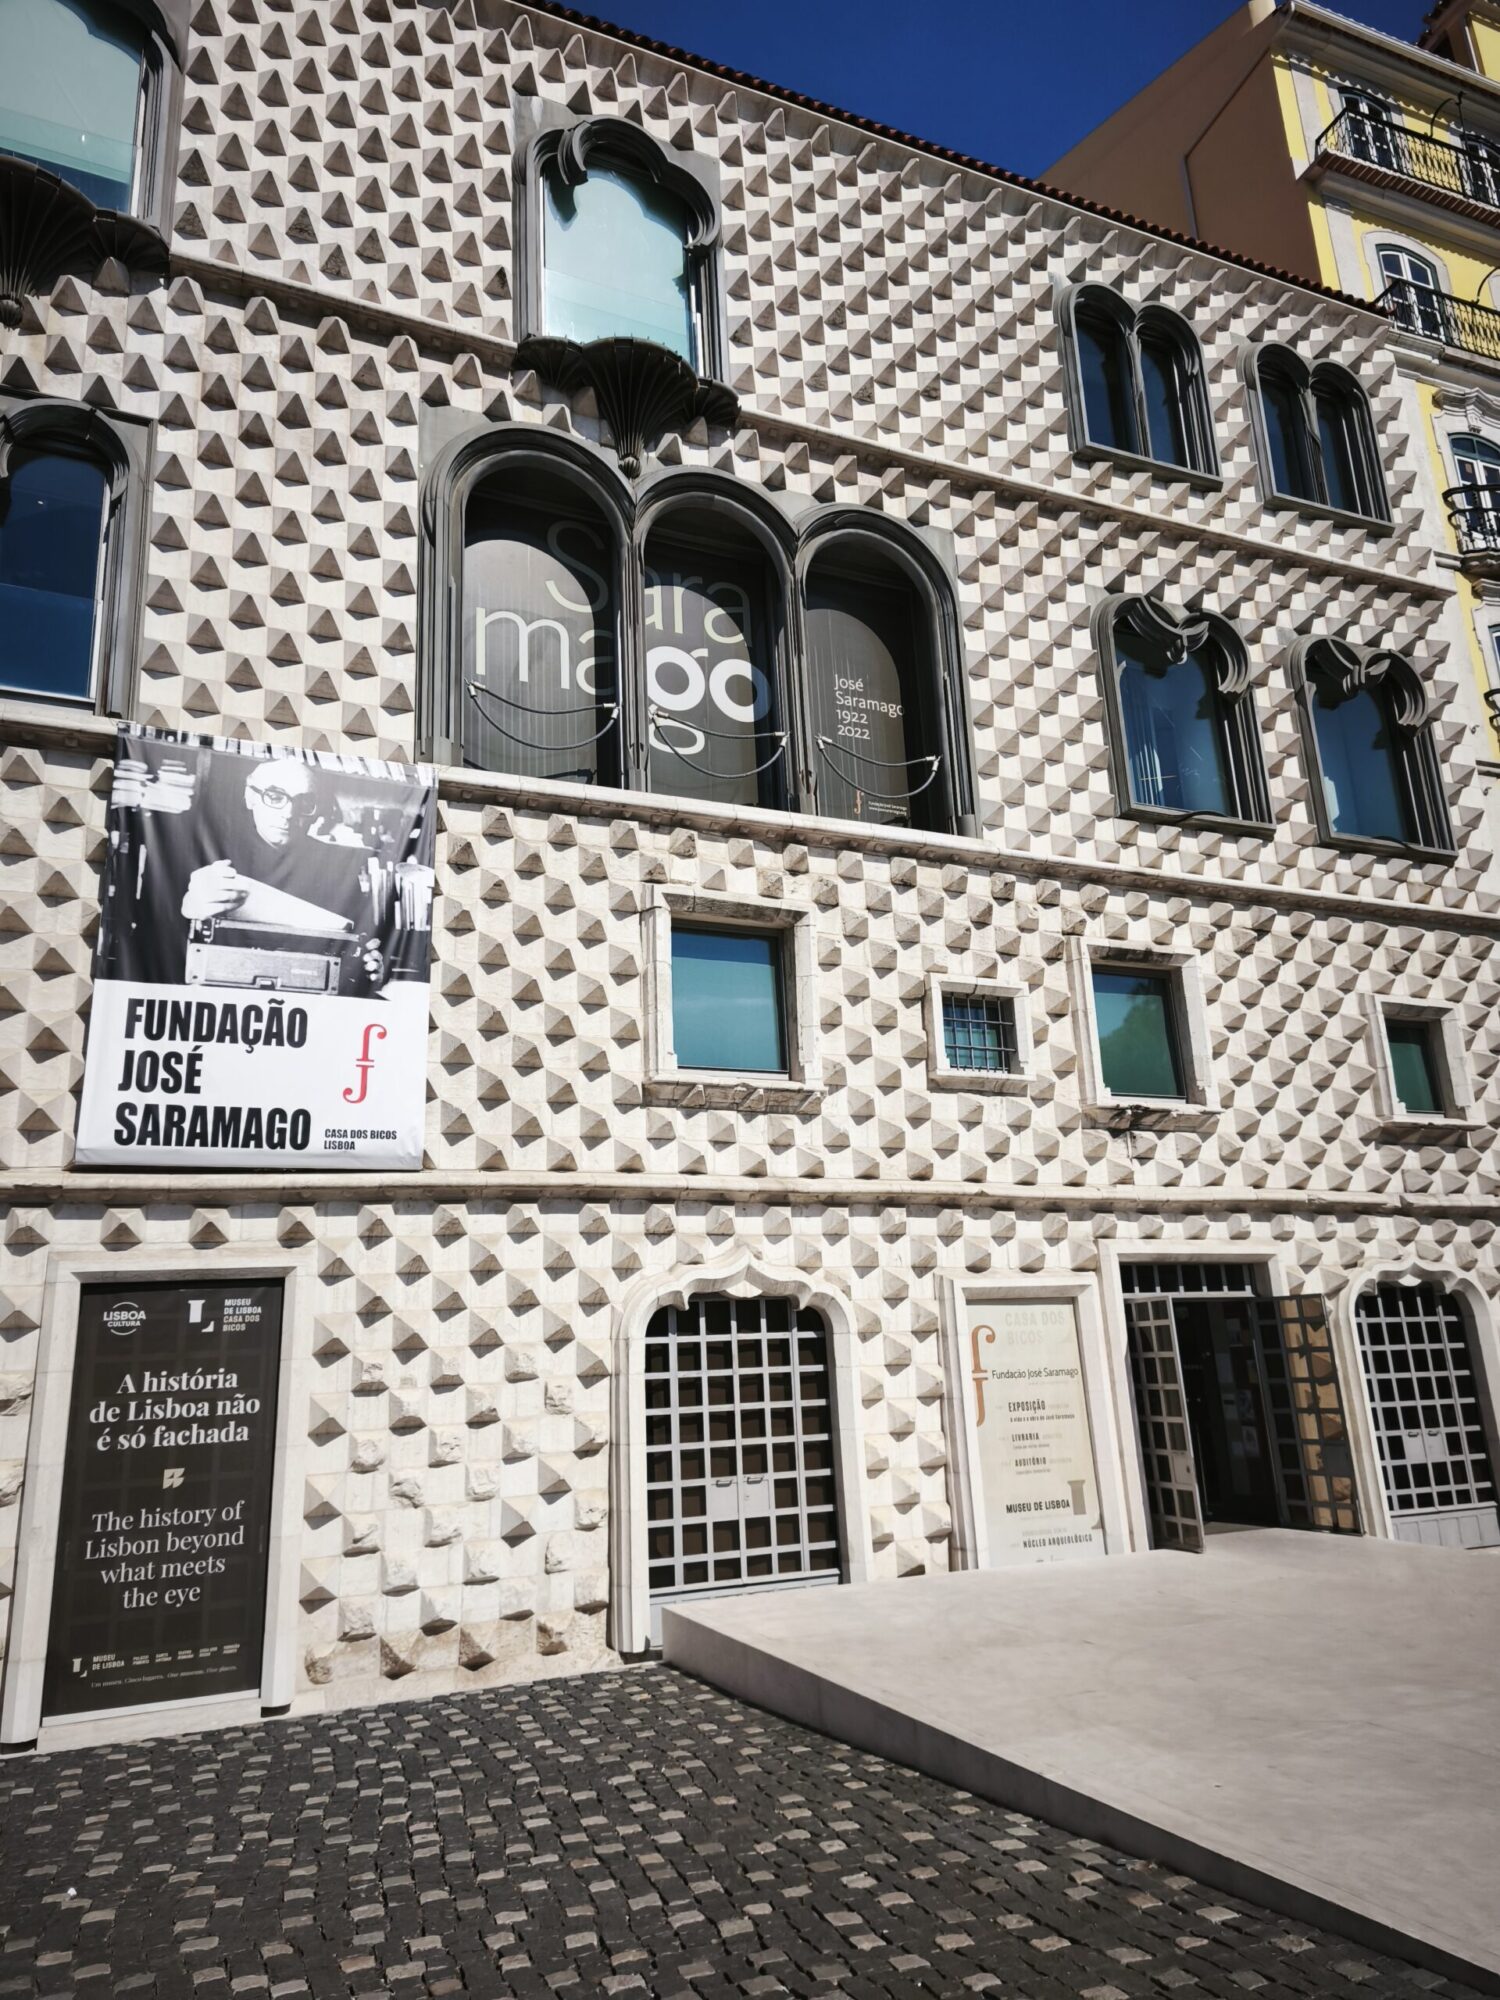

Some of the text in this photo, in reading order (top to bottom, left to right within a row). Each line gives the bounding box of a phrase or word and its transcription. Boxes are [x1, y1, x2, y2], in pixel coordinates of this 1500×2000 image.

[834, 674, 864, 692] José
[835, 690, 905, 718] Saramago
[836, 709, 869, 724] 1922
[836, 724, 871, 740] 2022
[124, 996, 308, 1054] FUNDAÇÃO
[118, 1046, 203, 1094] JOSÉ
[114, 1102, 311, 1151] SARAMAGO
[324, 1128, 398, 1140] CASA DOS BICOS
[324, 1140, 356, 1151] LISBOA
[224, 1298, 252, 1306] MUSEU
[103, 1310, 146, 1320] LISBOA
[236, 1306, 262, 1314] LISBOA
[107, 1320, 142, 1328] CULTURA
[223, 1314, 260, 1323] CASA DOS
[1004, 1310, 1065, 1326] CASA DOS
[222, 1323, 246, 1332] BICOS
[1006, 1330, 1045, 1345] BICOS
[992, 1366, 1079, 1380] Fundação José Saramago
[116, 1368, 238, 1394] A história
[89, 1392, 261, 1424] de Lisboa não
[1008, 1398, 1046, 1414] EXPOSIÇÃO
[96, 1421, 250, 1452] é só fachada
[1011, 1432, 1040, 1442] LIVRARIA
[1014, 1456, 1047, 1467] AUDITÓRIO
[1006, 1499, 1070, 1514] MUSEU DE LISBOA
[92, 1500, 245, 1532] The history of
[84, 1525, 245, 1561] Lisbon beyond
[1022, 1533, 1093, 1549] NÚCLEO ARQUEOLÓGICO
[100, 1556, 226, 1584] what meets
[122, 1584, 201, 1609] the eye
[92, 1654, 116, 1662] MUSEU
[102, 1660, 125, 1670] LISBOA
